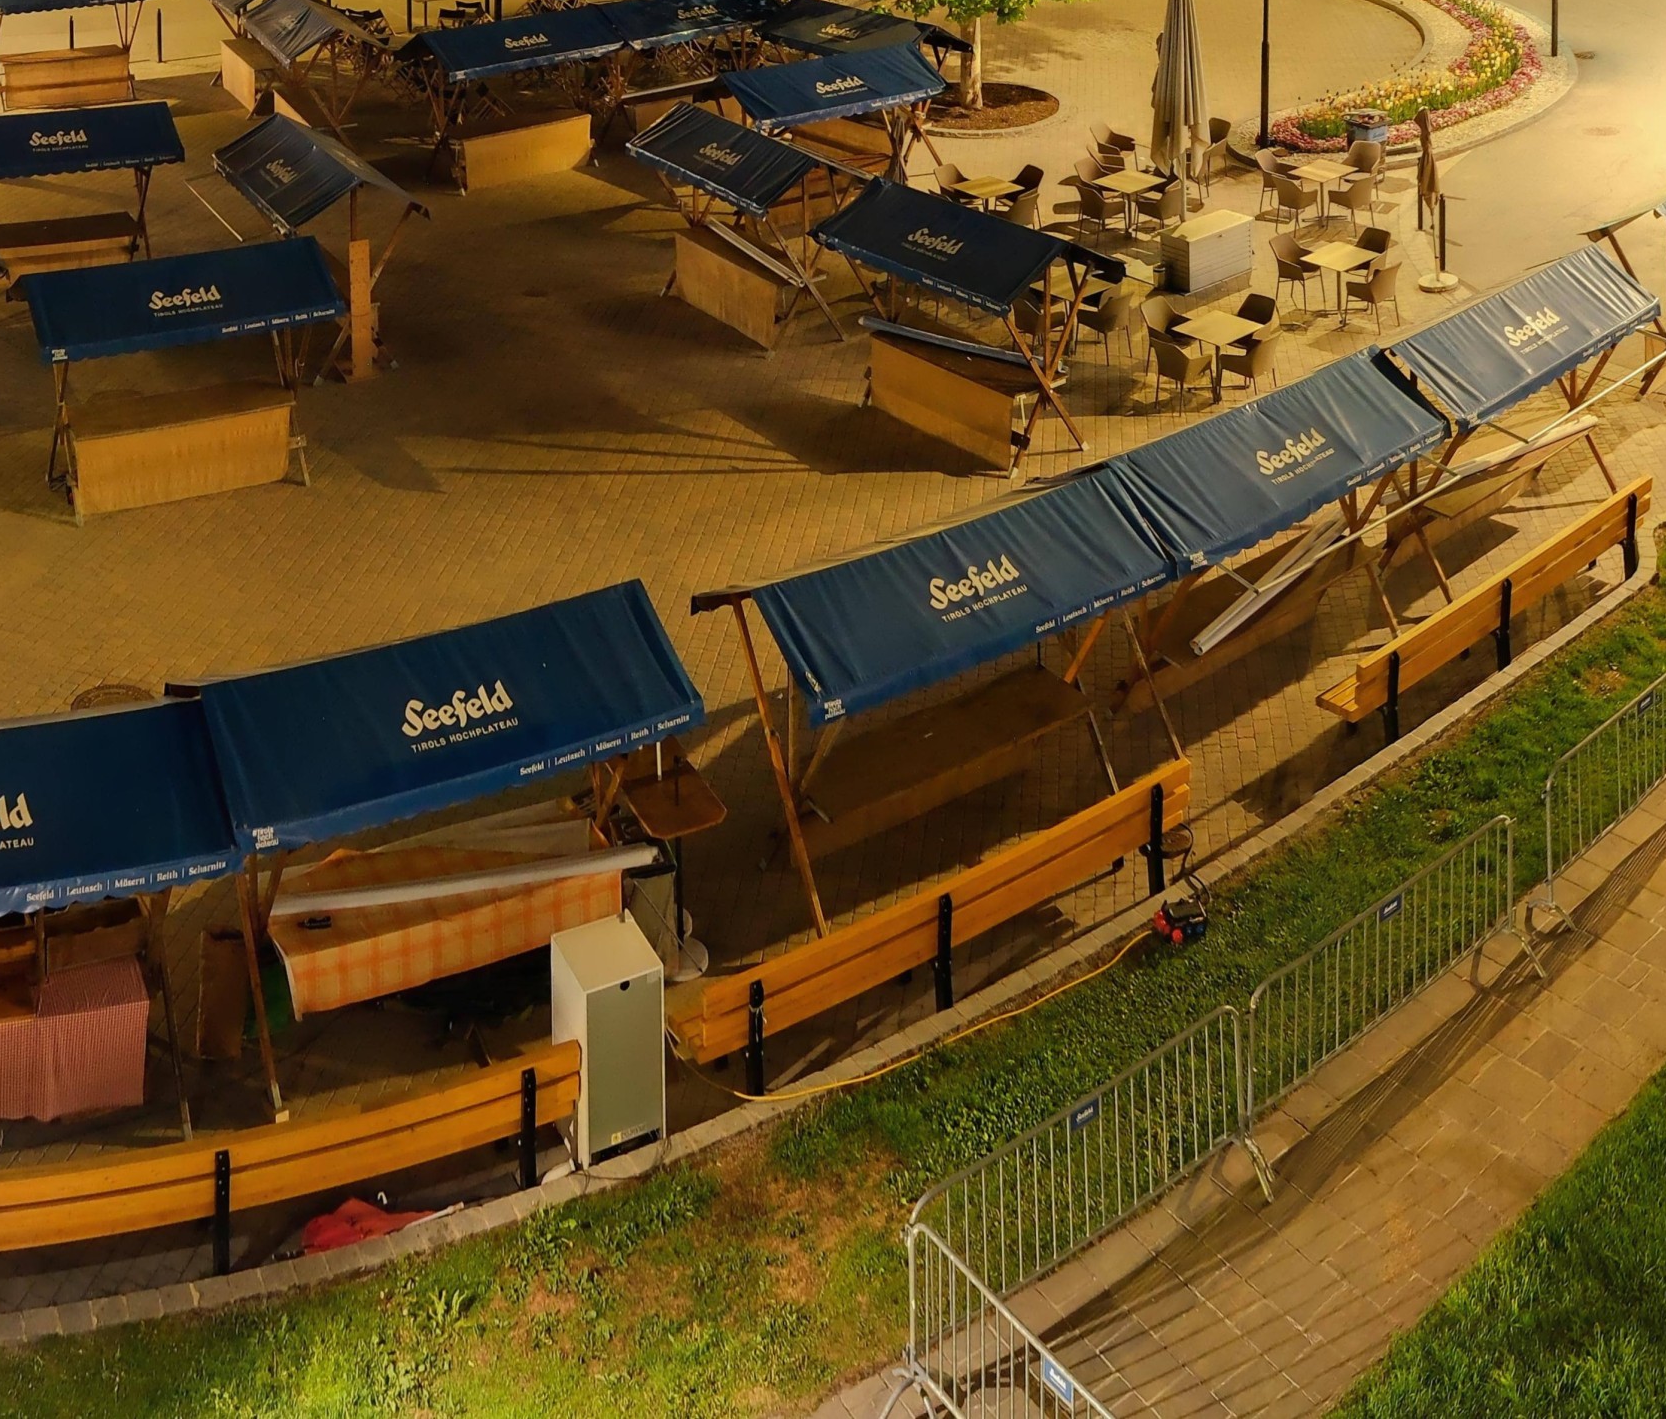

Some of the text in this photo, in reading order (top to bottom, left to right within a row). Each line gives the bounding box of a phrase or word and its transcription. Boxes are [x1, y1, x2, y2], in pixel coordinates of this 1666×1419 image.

[677, 4, 719, 20] Seefeld
[504, 32, 549, 50] Seefeld
[815, 75, 865, 95] Seefeld
[28, 128, 89, 147] Seefeld
[699, 142, 744, 166] Seefeld
[907, 227, 964, 256] Seefeld
[148, 284, 222, 311] Seefeld
[1503, 307, 1561, 348] Seefeld
[1255, 427, 1327, 476] Seefeld
[928, 553, 1022, 611] Seefeld
[940, 583, 1029, 624] TIROLS HOCHPLATEAU
[400, 678, 515, 739] Seefeld
[410, 716, 520, 754] TIROLS HOCHPLATEAU
[519, 760, 546, 777] Seefeld
[554, 746, 587, 766] Leutasch
[630, 725, 650, 742] Reith
[26, 888, 56, 902] Seefeld
[66, 881, 104, 897] Leutasch
[156, 868, 180, 883] Reith
